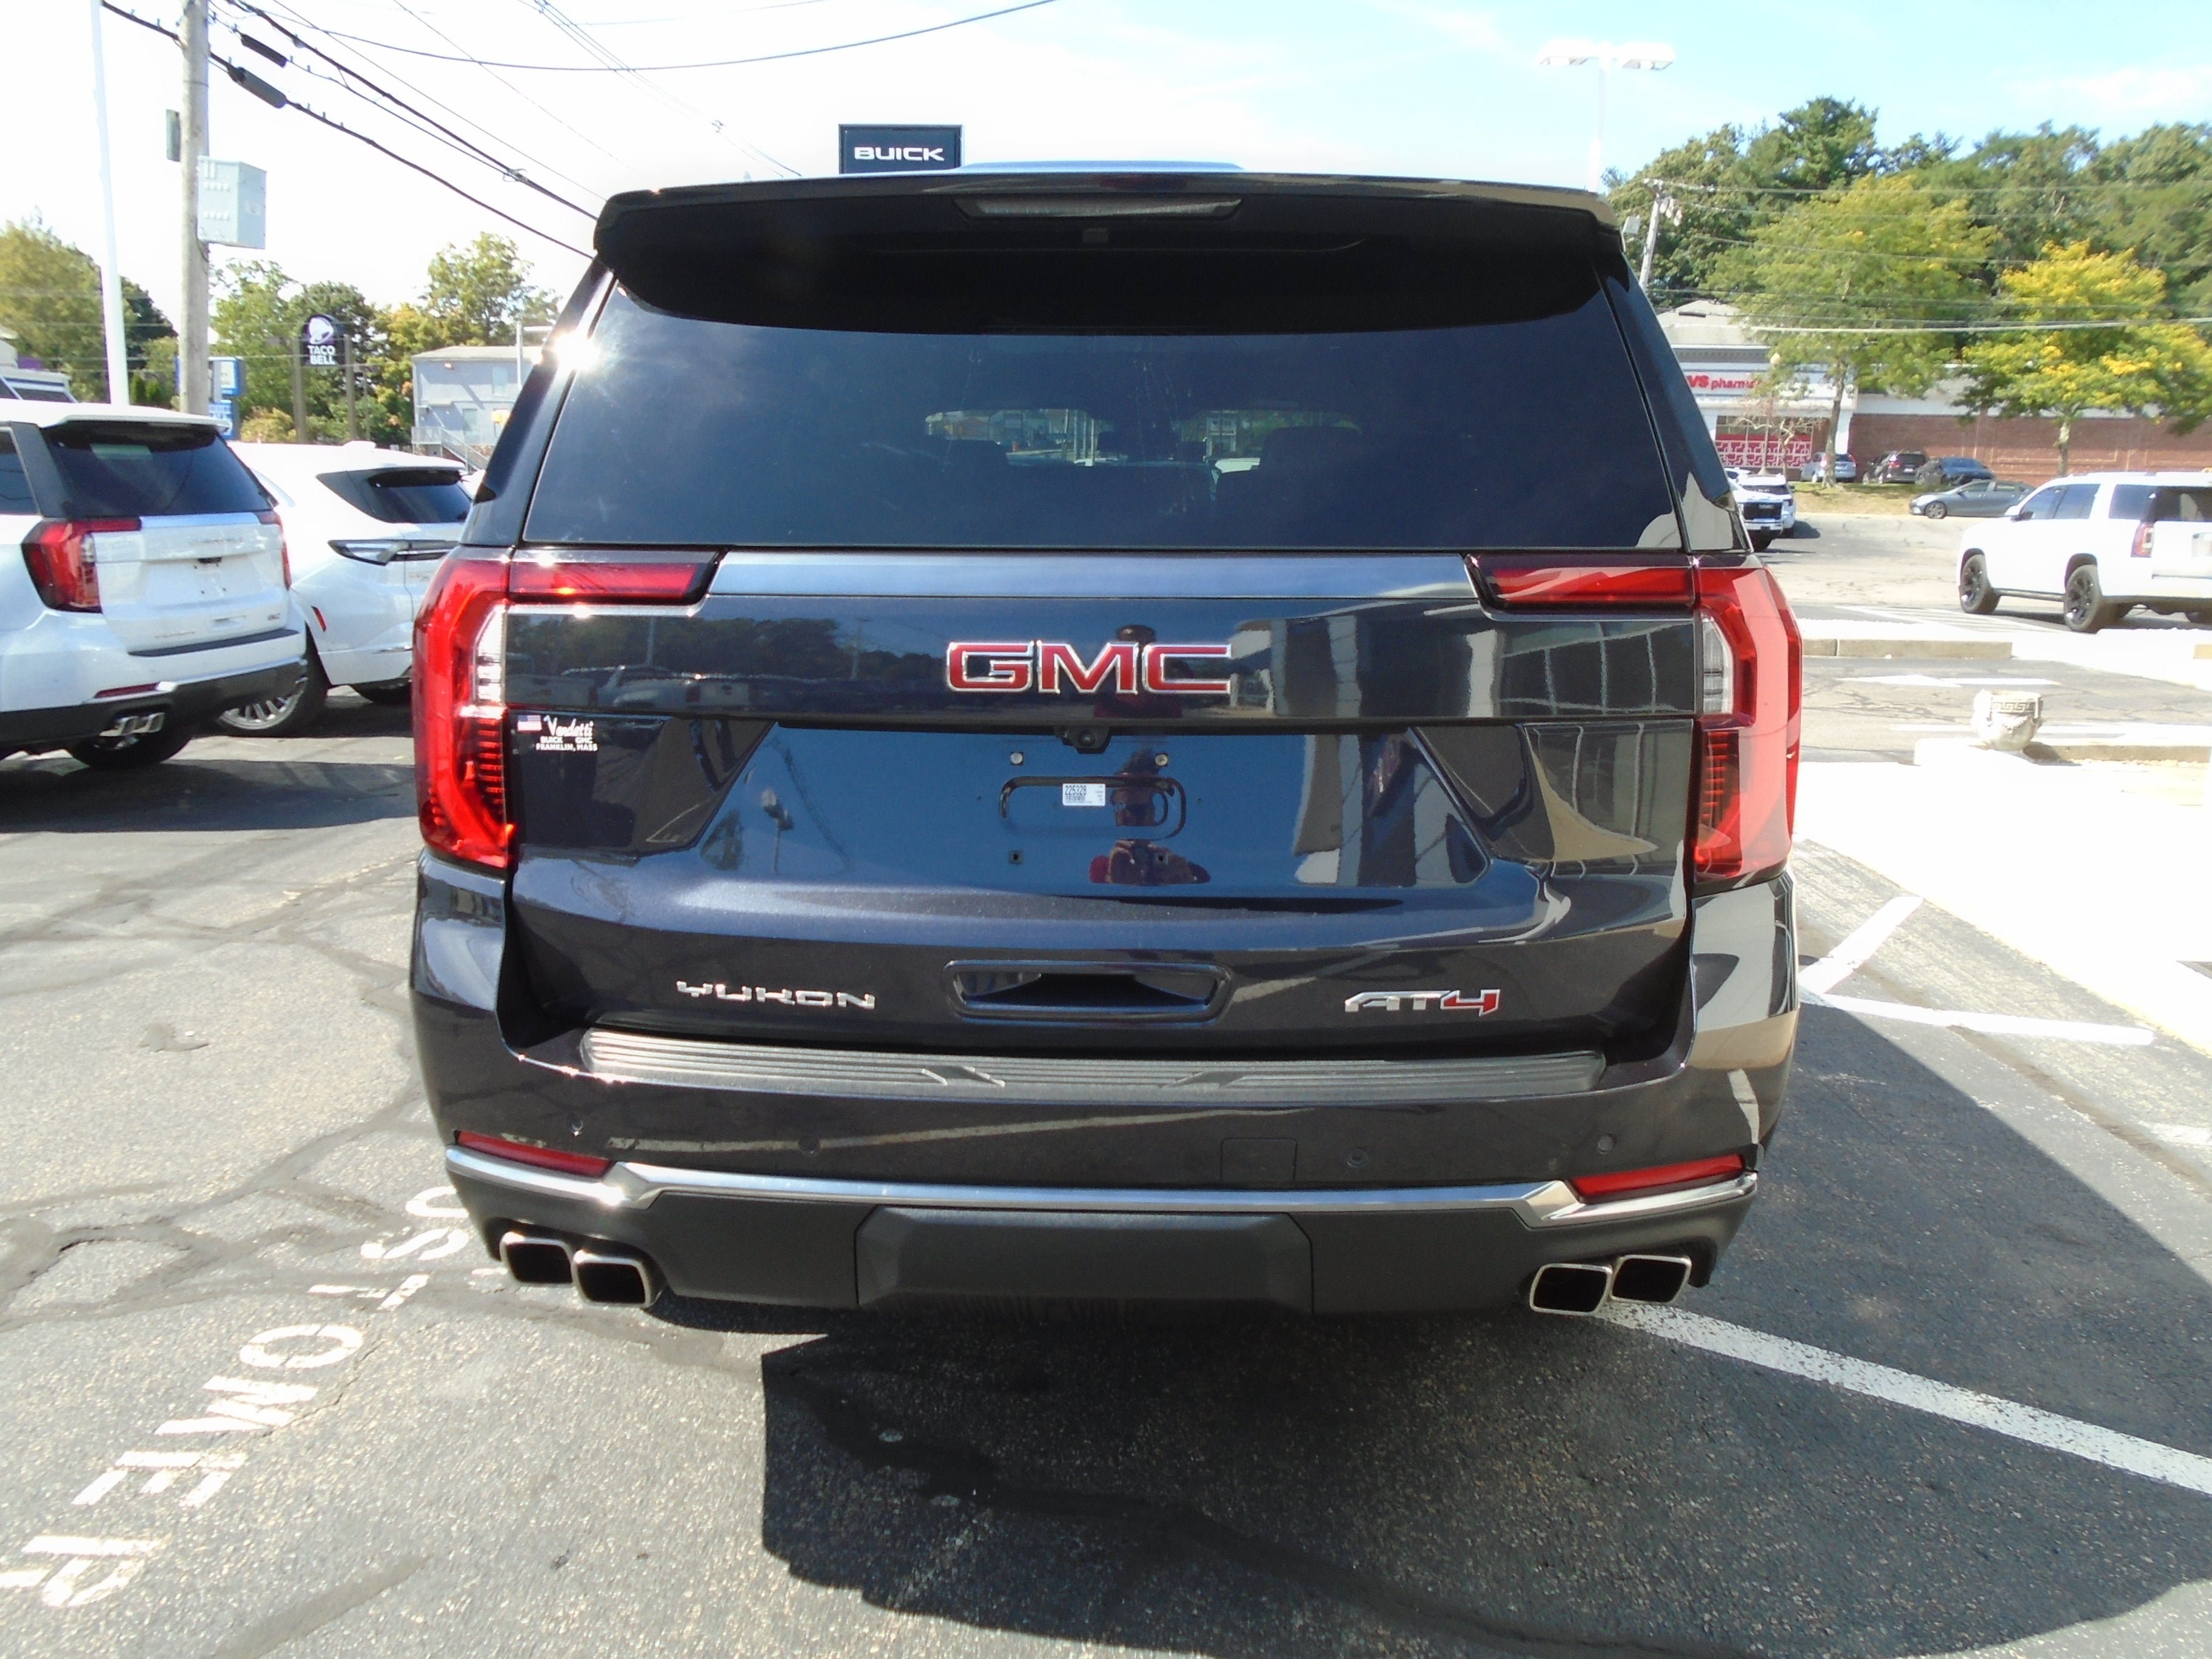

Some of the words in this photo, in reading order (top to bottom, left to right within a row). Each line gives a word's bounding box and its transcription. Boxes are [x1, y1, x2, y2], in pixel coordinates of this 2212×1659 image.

[854, 147, 945, 161] BUICK
[307, 345, 336, 355] TACO
[310, 355, 335, 365] BELL
[1686, 375, 1709, 388] VS
[947, 641, 1232, 694] GMC
[543, 715, 594, 736] Vendetti
[535, 743, 576, 751] FRANKLIN,
[677, 980, 875, 1010] YUKON
[1345, 990, 1501, 1017] AT4
[0, 1185, 470, 1607] USTOMER
